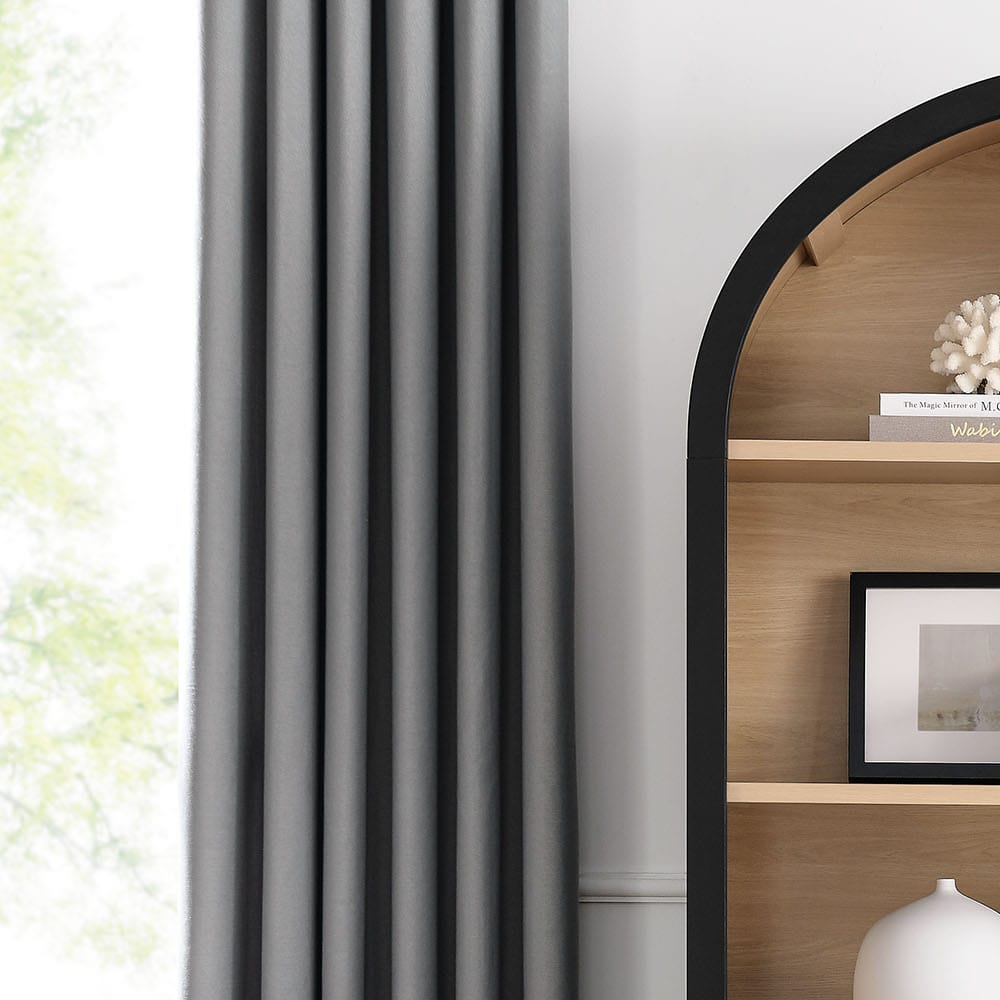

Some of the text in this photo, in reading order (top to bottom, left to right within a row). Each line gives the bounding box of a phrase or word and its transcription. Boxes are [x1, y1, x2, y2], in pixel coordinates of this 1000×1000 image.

[904, 401, 918, 409] The
[919, 401, 942, 410] Magic
[950, 422, 1000, 438] Wabi
